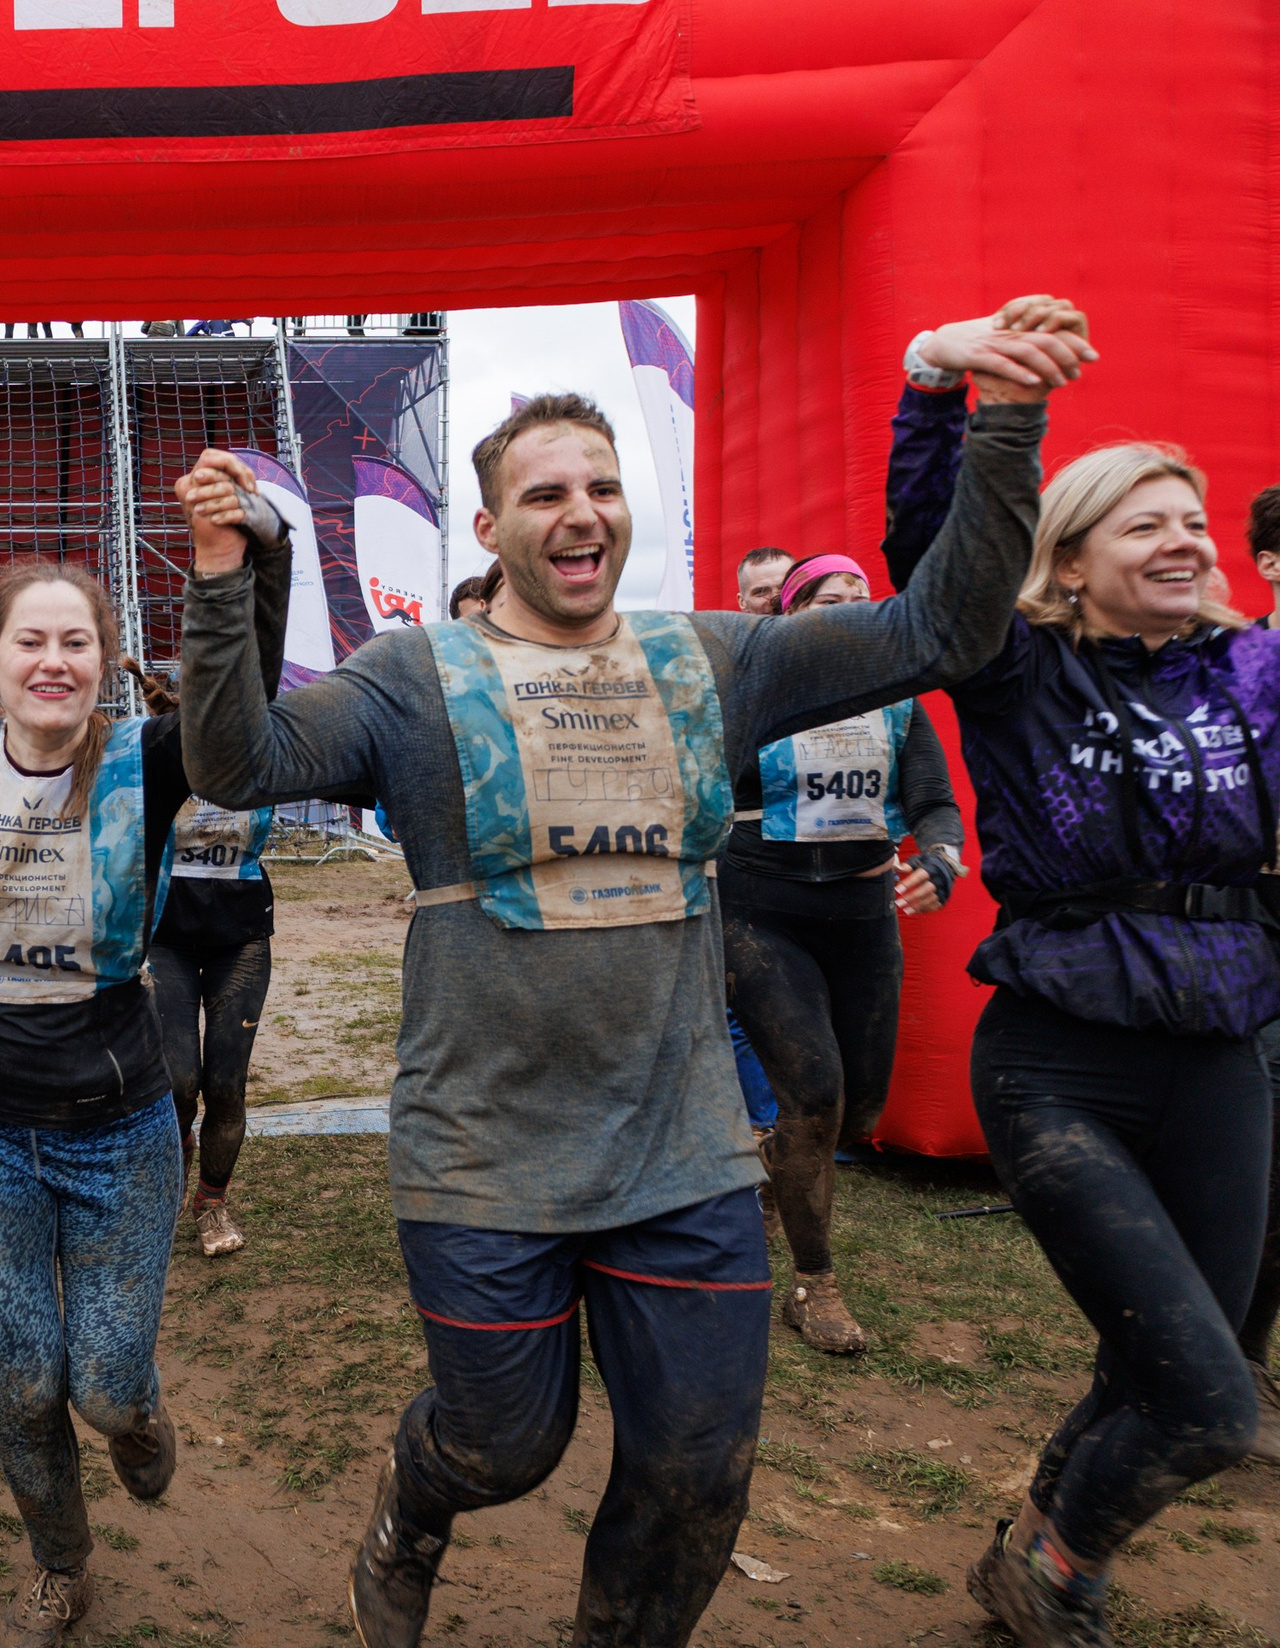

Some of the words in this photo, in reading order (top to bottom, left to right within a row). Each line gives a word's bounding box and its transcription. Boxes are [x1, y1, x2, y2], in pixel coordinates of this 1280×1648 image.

[514, 680, 580, 696] ГОНКА
[583, 680, 649, 696] ГЕРОЕВ
[542, 707, 640, 731] Sminex
[548, 742, 646, 752] ПЕРФЕКЦИОНИСТЫ
[550, 755, 573, 764] FINE
[577, 754, 647, 764] DEVELOPMENT
[807, 770, 882, 801] 5403
[28, 815, 82, 830] ГЕРОЕВ
[2, 884, 67, 892] DEVELOPMENT
